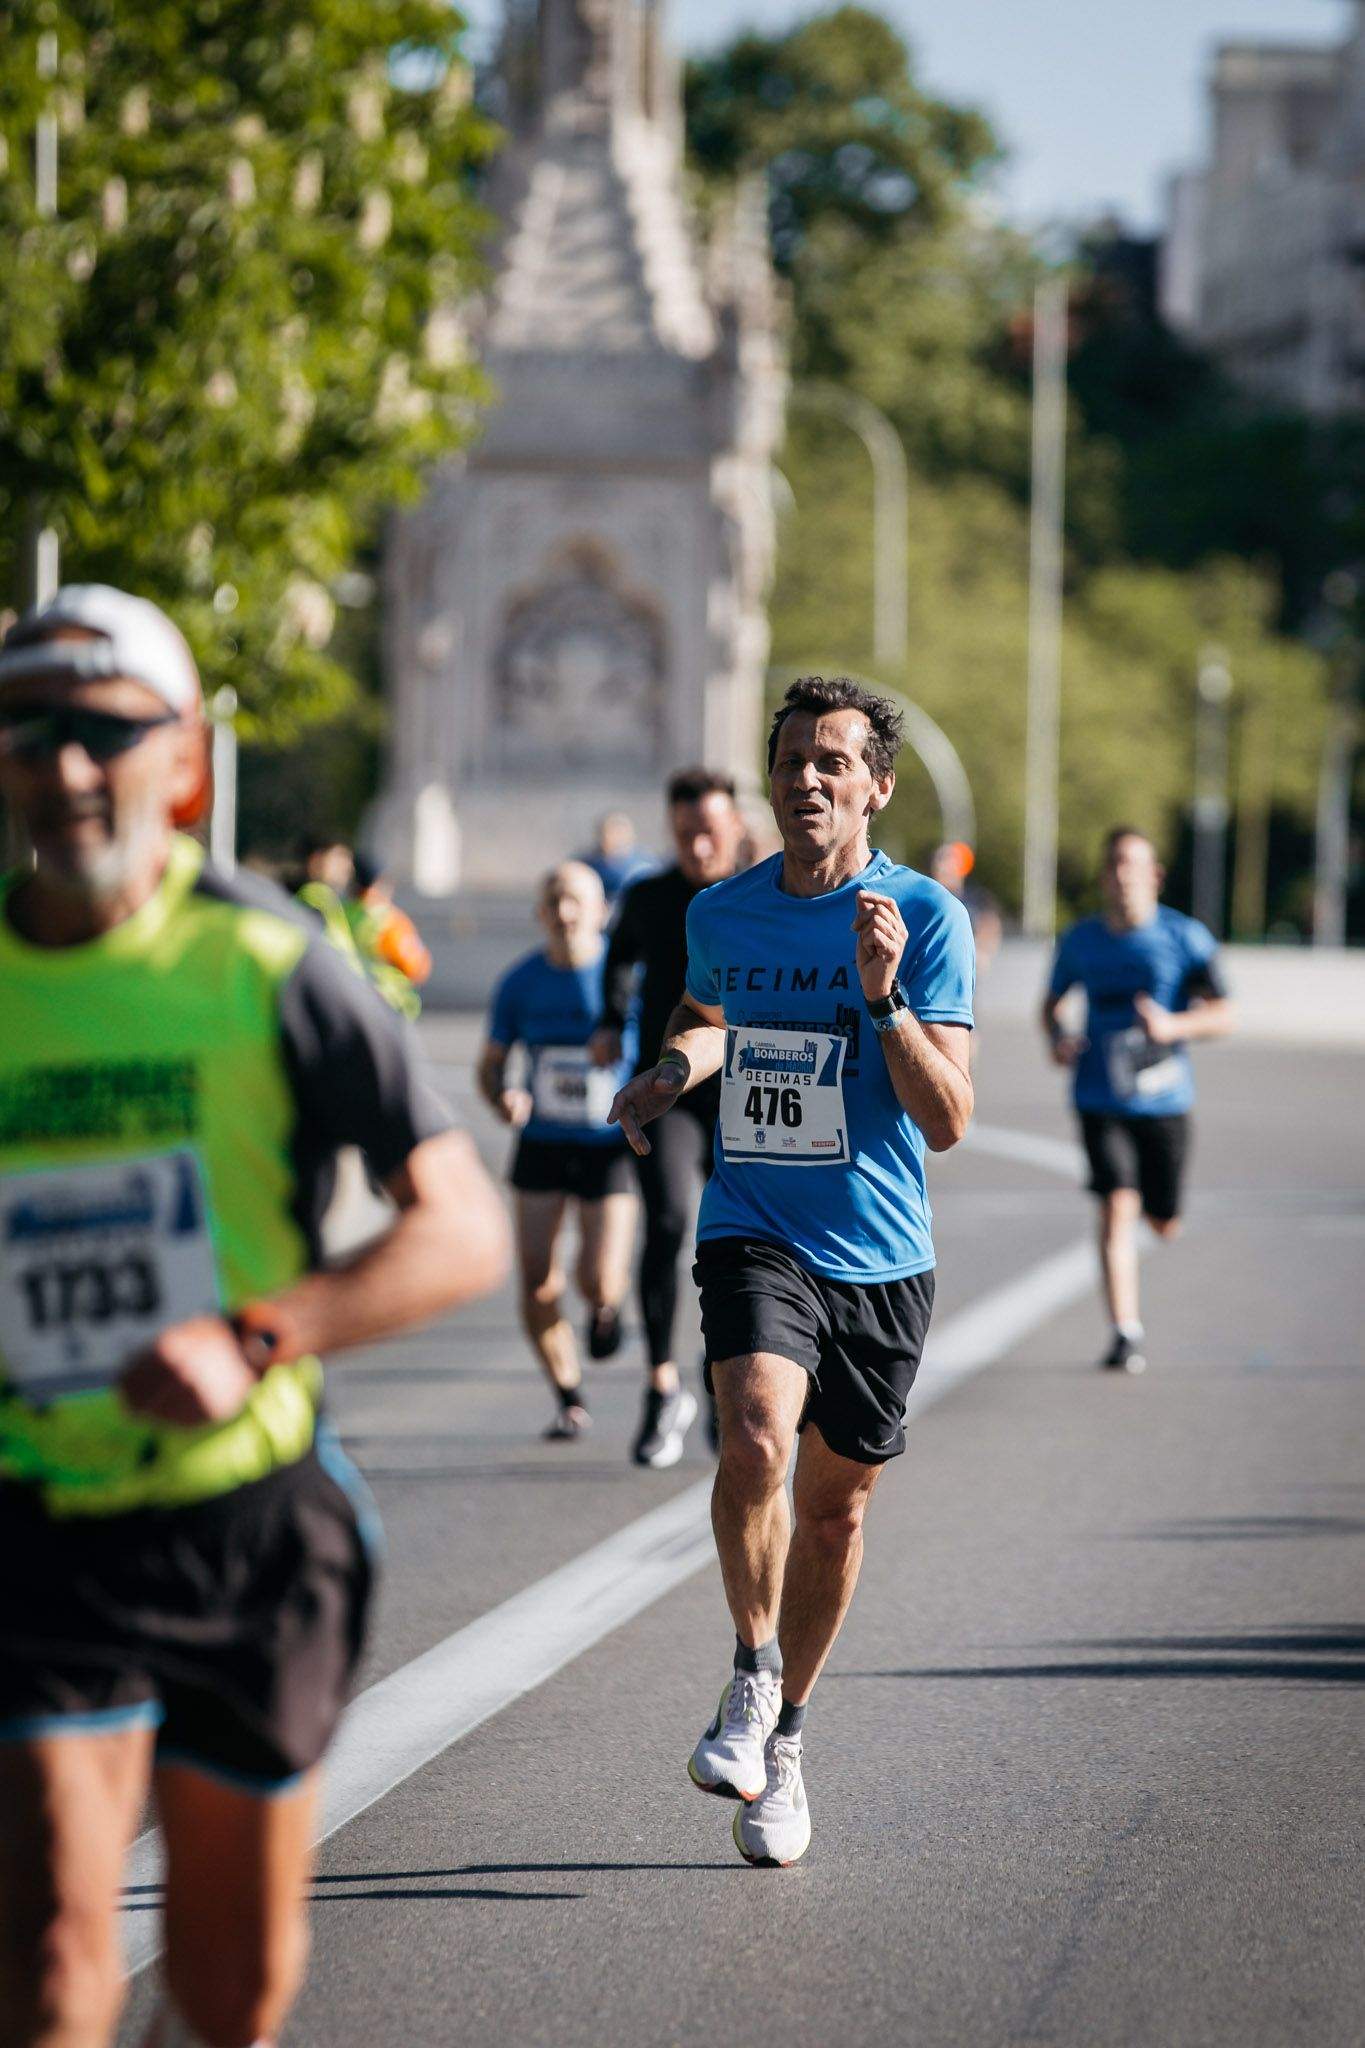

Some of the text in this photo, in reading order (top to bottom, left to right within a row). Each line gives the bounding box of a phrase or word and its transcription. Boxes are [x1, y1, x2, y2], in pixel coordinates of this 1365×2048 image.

[711, 965, 850, 993] DECIMA
[754, 1048, 814, 1063] BOMBEROS
[746, 1070, 811, 1086] DECIMAS
[744, 1085, 803, 1128] 476
